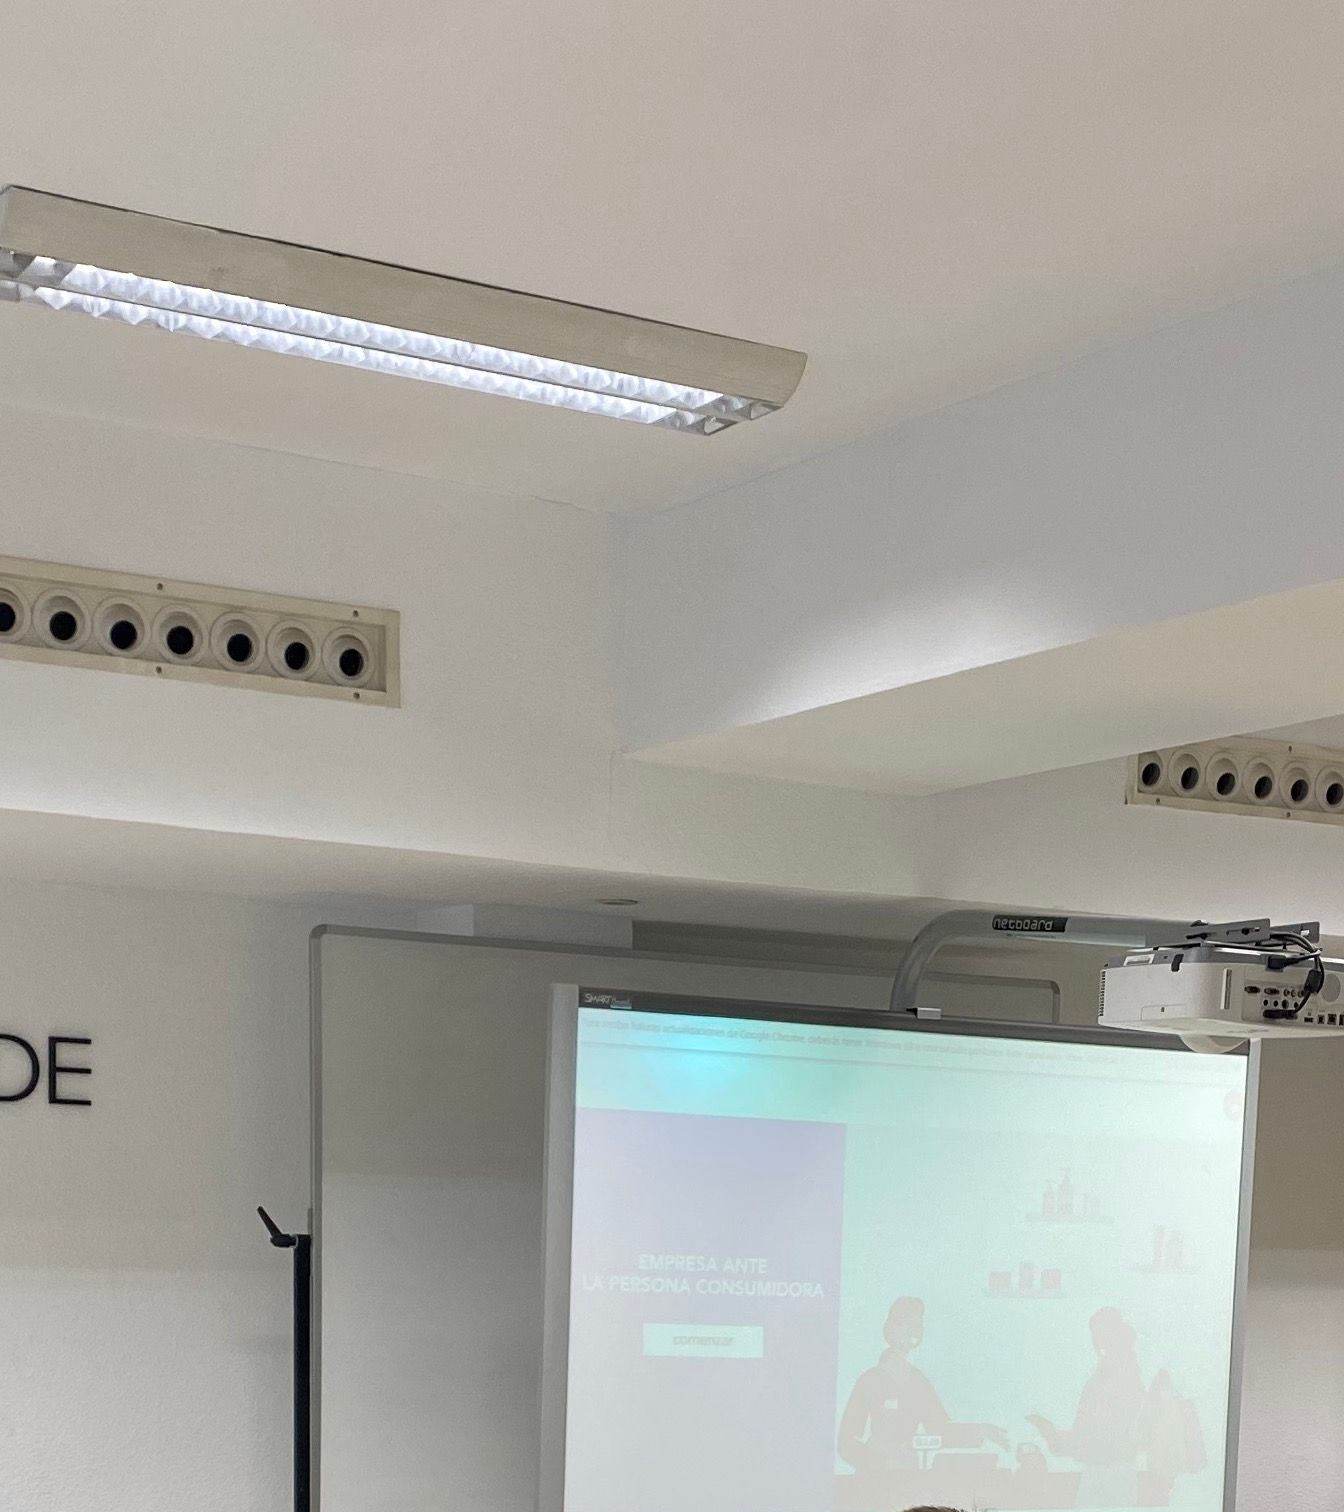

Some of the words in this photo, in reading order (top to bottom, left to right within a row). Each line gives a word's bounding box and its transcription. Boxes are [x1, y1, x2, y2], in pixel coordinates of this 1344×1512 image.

[638, 1253, 718, 1273] EMPRESA
[722, 1257, 769, 1275] ANTE
[581, 1275, 604, 1291] LA
[608, 1275, 690, 1294] PERSONA
[696, 1278, 825, 1299] CONSUMIDORA
[672, 1334, 735, 1347] comenzar
